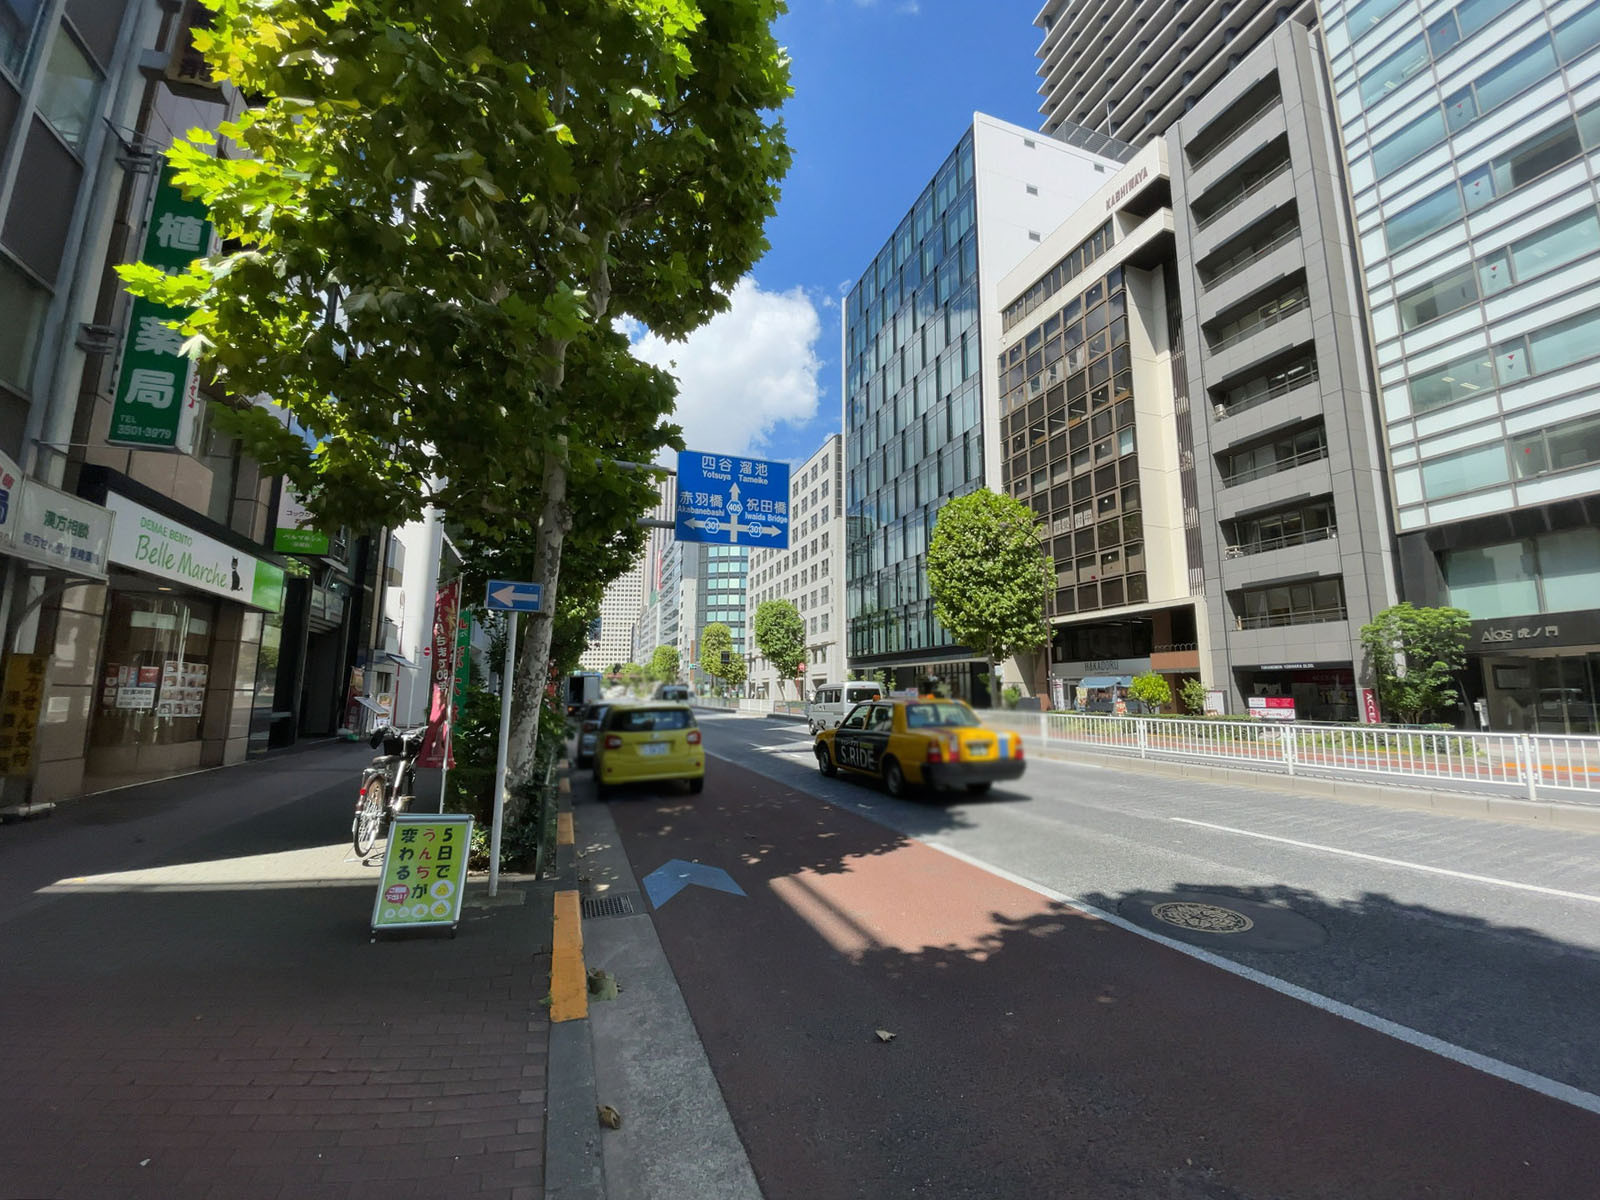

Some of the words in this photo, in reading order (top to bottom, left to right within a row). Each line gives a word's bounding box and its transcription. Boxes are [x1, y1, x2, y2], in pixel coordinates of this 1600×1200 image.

[124, 212, 204, 409] 植薬局
[120, 415, 136, 424] TEL
[702, 455, 733, 472] 四谷
[739, 460, 768, 477] 溜池
[702, 470, 732, 481] Yotsuya
[680, 491, 723, 508] 赤羽橋
[729, 503, 741, 512] 405
[746, 498, 787, 515] 祝田橋
[706, 521, 720, 530] 301
[767, 513, 788, 525] Bridge
[140, 516, 168, 537] DEMAE
[169, 529, 193, 547] BENTO
[749, 524, 762, 533] 301
[135, 534, 175, 569] Belle
[177, 551, 227, 588] Marche
[1517, 625, 1559, 639] 虎ノ門
[396, 828, 419, 880] 変わる
[436, 828, 453, 879] 5日で
[411, 828, 436, 899] うんちが
